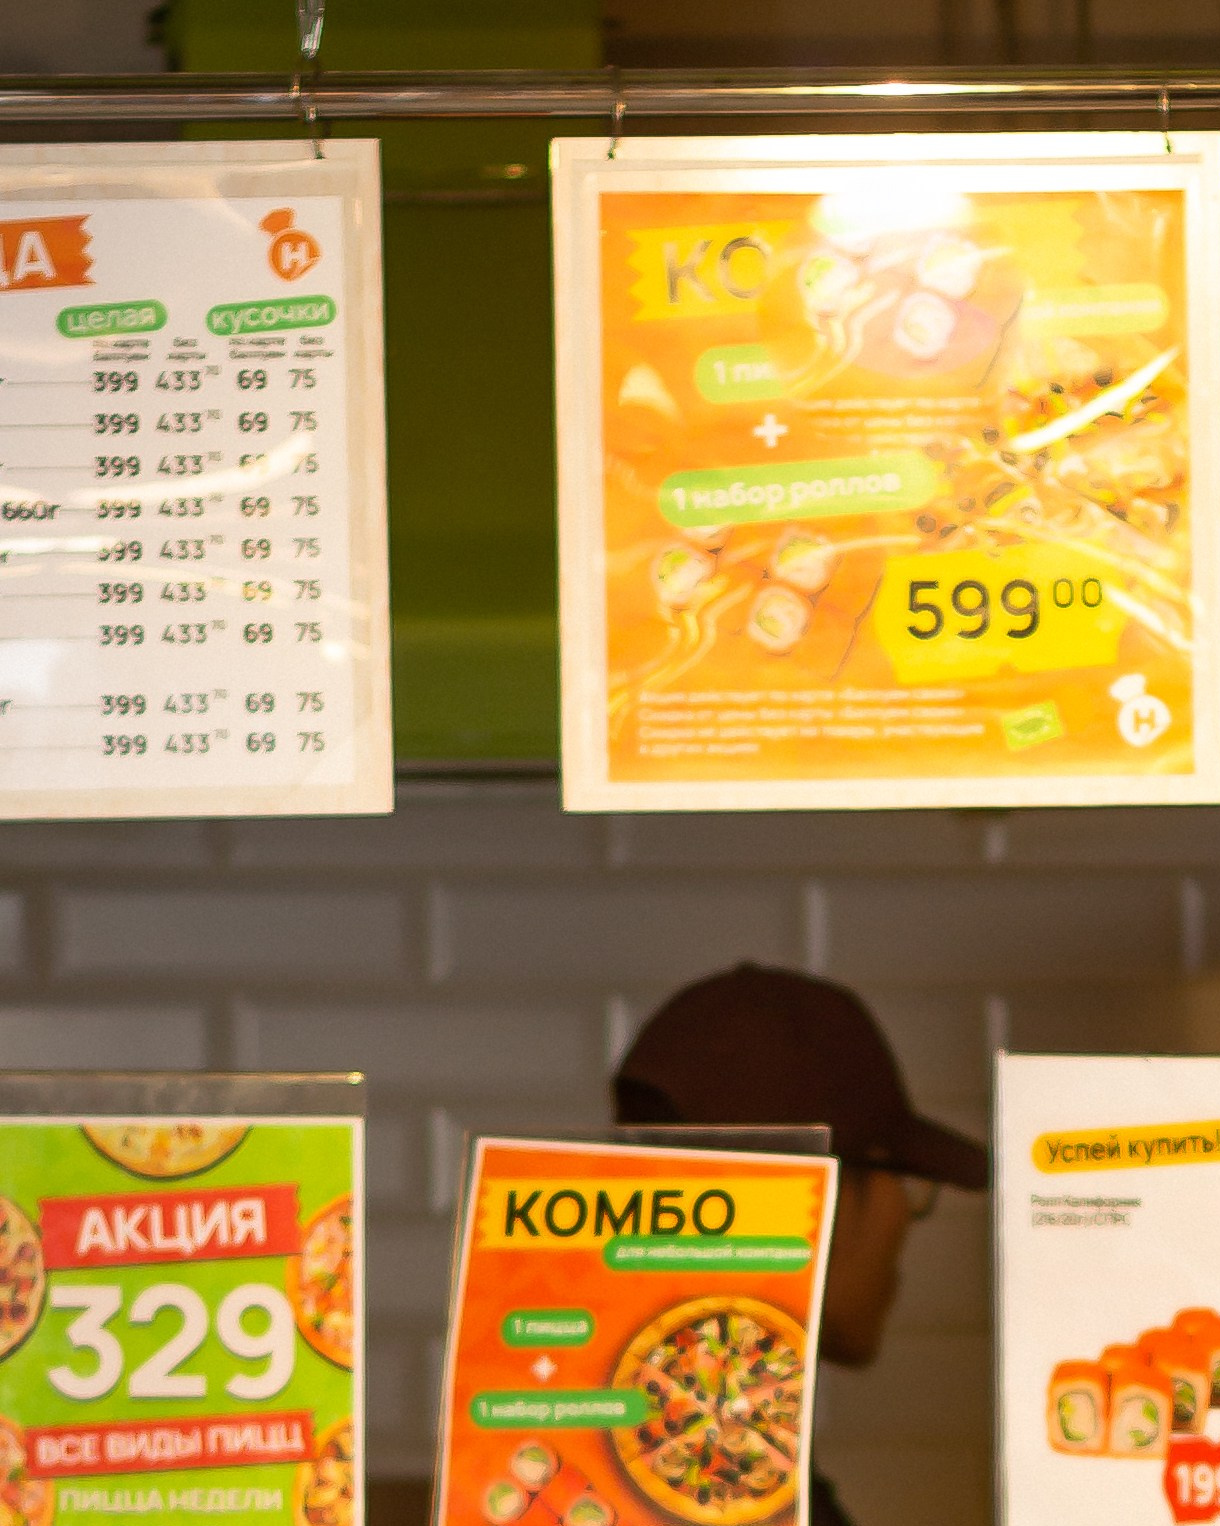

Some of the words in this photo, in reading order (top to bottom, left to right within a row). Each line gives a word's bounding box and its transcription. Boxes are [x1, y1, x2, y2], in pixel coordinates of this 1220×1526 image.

[66, 306, 157, 331] целая
[212, 302, 329, 335] кусочки
[94, 371, 138, 392] 399
[155, 371, 202, 391] 433
[237, 369, 267, 390] 69
[289, 368, 317, 389] 75
[713, 361, 726, 385] 1
[94, 413, 140, 433] 399
[156, 413, 203, 432] 433
[238, 412, 269, 432] 69
[289, 411, 318, 431] 75
[95, 456, 141, 477] 399
[157, 455, 204, 475] 433
[672, 488, 686, 512] 1
[692, 482, 785, 513] набор
[789, 472, 901, 509] роллов
[159, 498, 204, 518] 433
[240, 497, 271, 518] 69
[291, 496, 320, 516] 75
[160, 540, 205, 560] 433
[241, 538, 272, 560] 69
[292, 537, 321, 558] 75
[99, 583, 144, 603] 399
[161, 582, 207, 602] 433
[242, 581, 272, 601] 69
[292, 580, 321, 600] 75
[905, 578, 1041, 641] 599
[1052, 577, 1103, 609] 00
[100, 625, 144, 645] 399
[161, 623, 208, 643] 433
[243, 623, 273, 644] 69
[295, 622, 323, 642] 75
[101, 695, 147, 715] 399
[163, 693, 209, 713] 433
[245, 693, 276, 714] 69
[296, 691, 324, 712] 75
[102, 735, 147, 756] 399
[164, 734, 210, 754] 433
[246, 732, 276, 753] 69
[297, 731, 325, 752] 75
[1046, 1134, 1121, 1165] Успей
[1127, 1128, 1220, 1166] купить!
[504, 1188, 736, 1238] КОМБО
[76, 1199, 266, 1259] АКЦИЯ
[47, 1282, 297, 1401] 329
[36, 1433, 100, 1468] ВСЕ
[105, 1426, 201, 1463] ВИДЫ
[205, 1422, 306, 1455] ПИЦЦ
[59, 1487, 164, 1514] ПИЦЦА
[169, 1487, 284, 1513] НЕДЕЛИ
